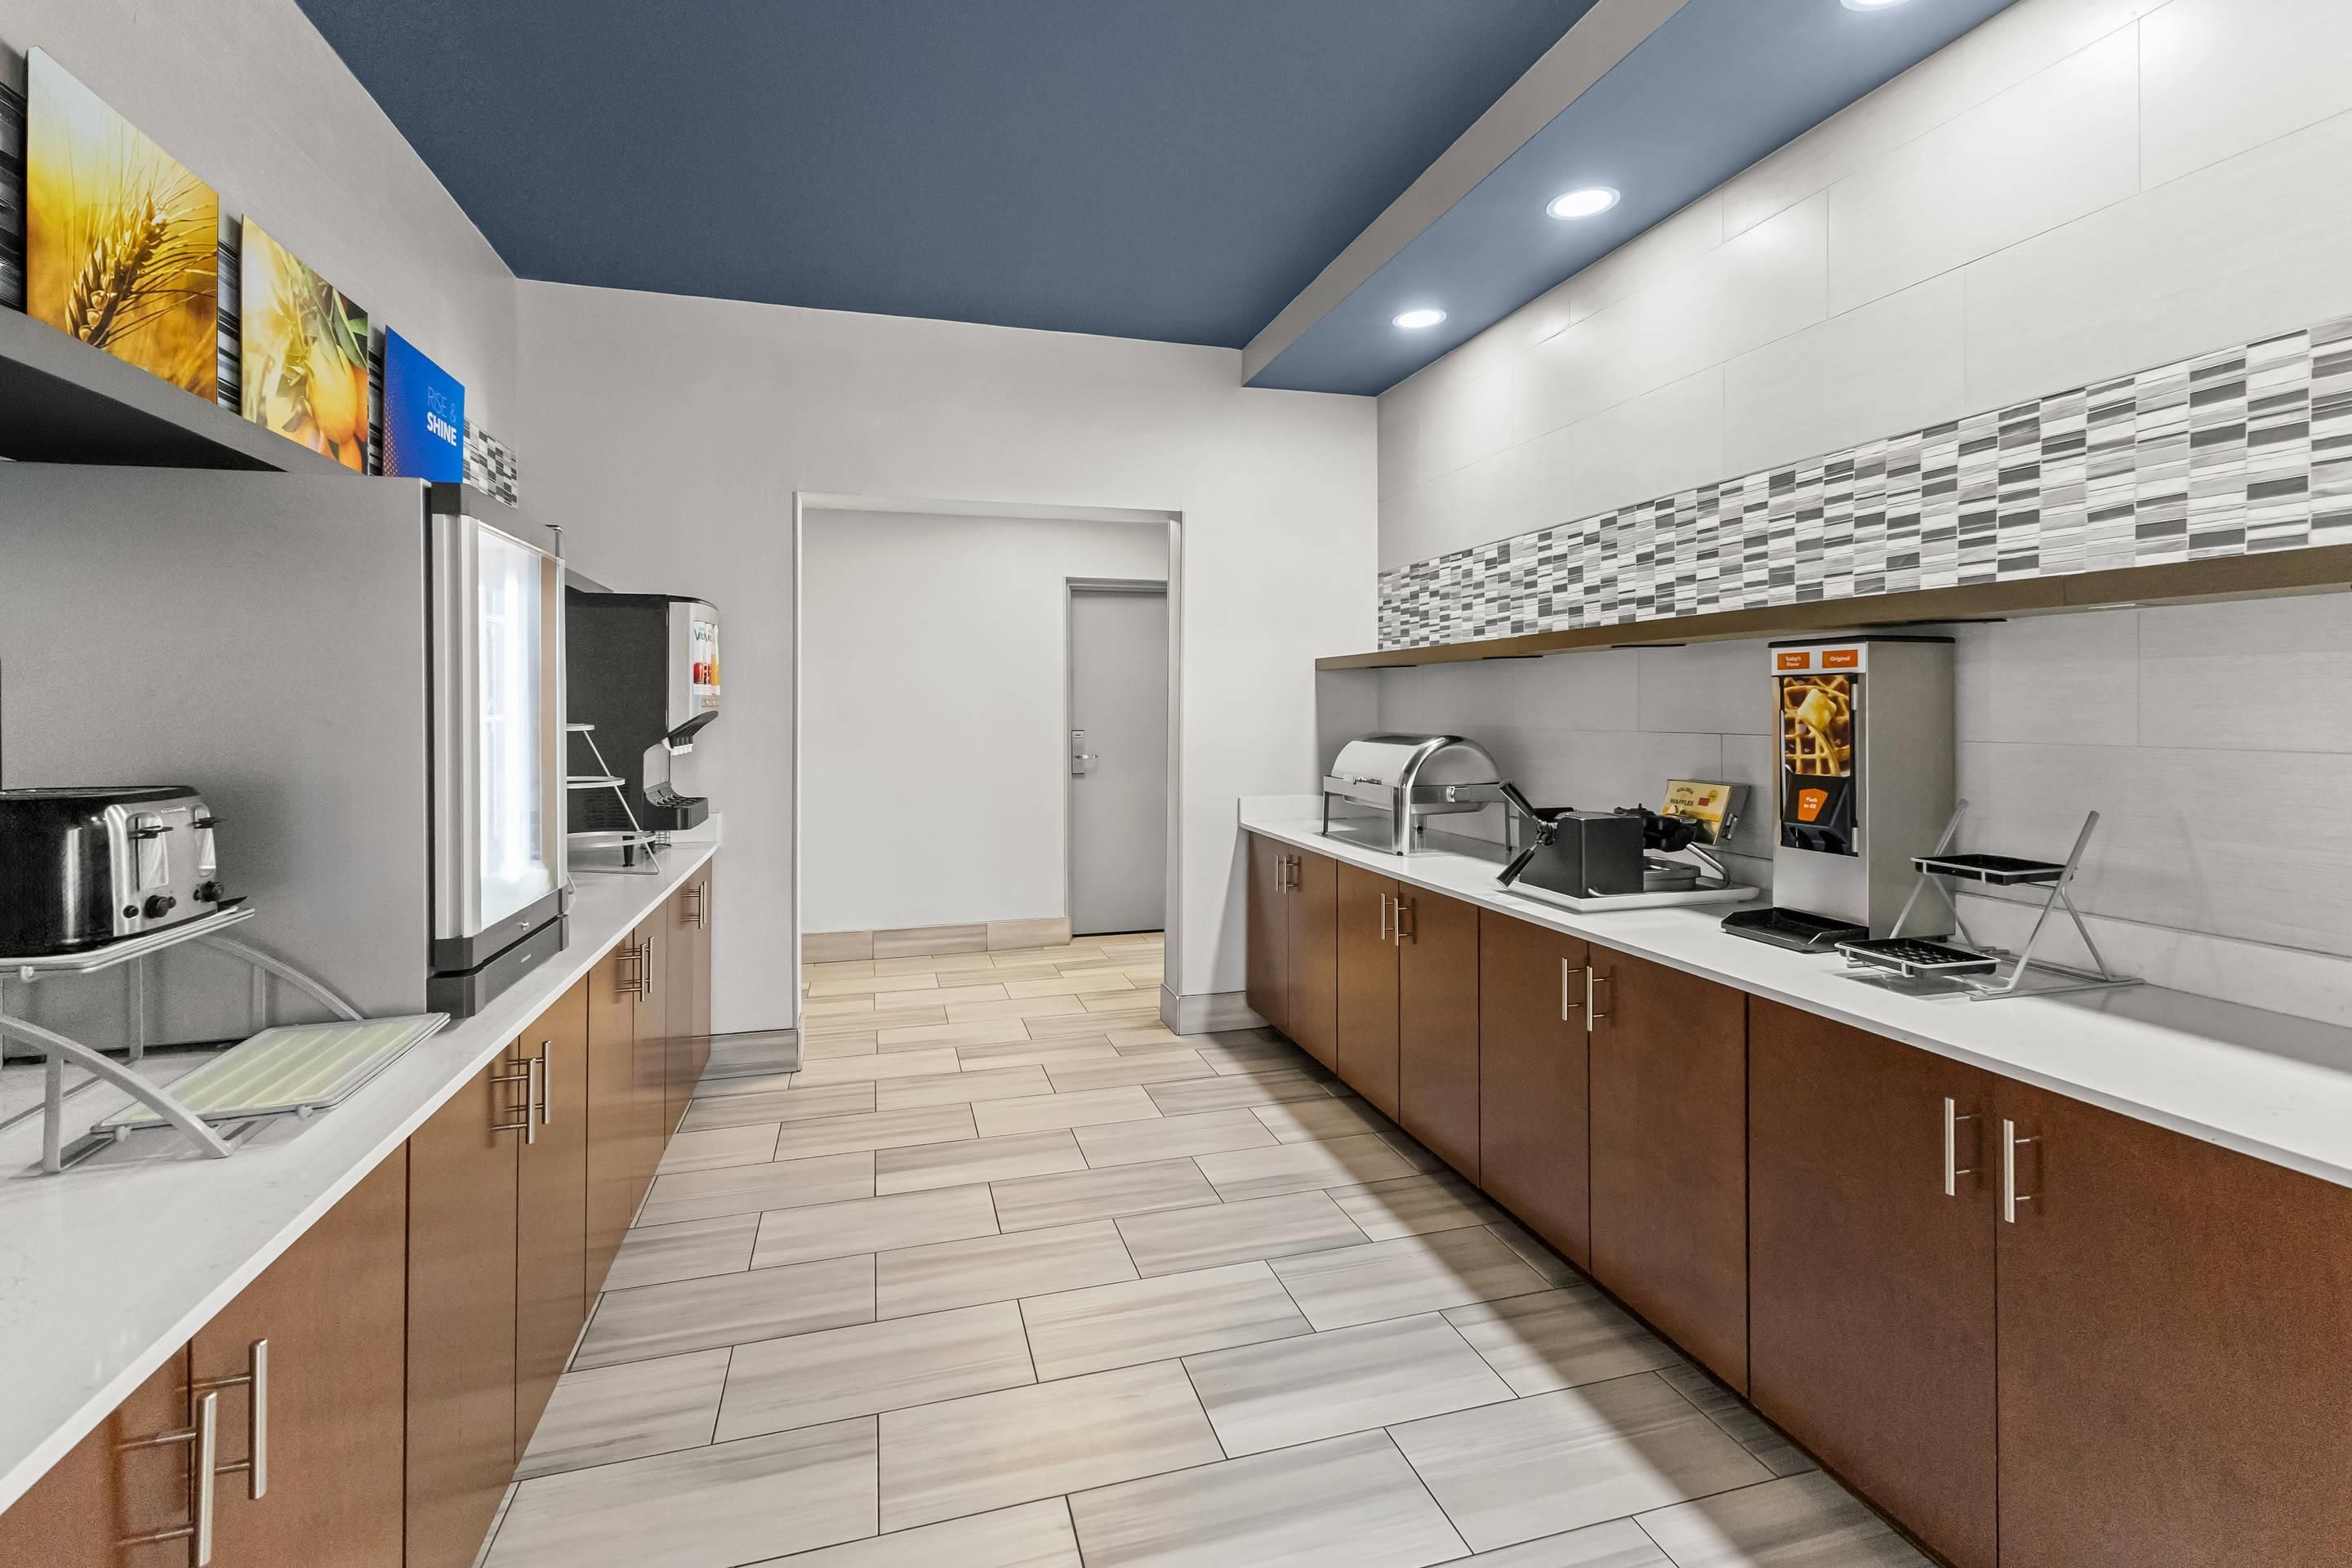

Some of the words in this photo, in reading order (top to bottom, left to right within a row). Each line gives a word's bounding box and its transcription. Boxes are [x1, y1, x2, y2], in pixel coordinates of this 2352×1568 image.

[427, 385, 448, 418] RISE
[450, 403, 457, 423] &
[426, 411, 457, 448] SHINE
[1829, 655, 1851, 663] Original
[1677, 786, 1694, 795] GOLDEN
[1669, 798, 1694, 806] WAFFLES
